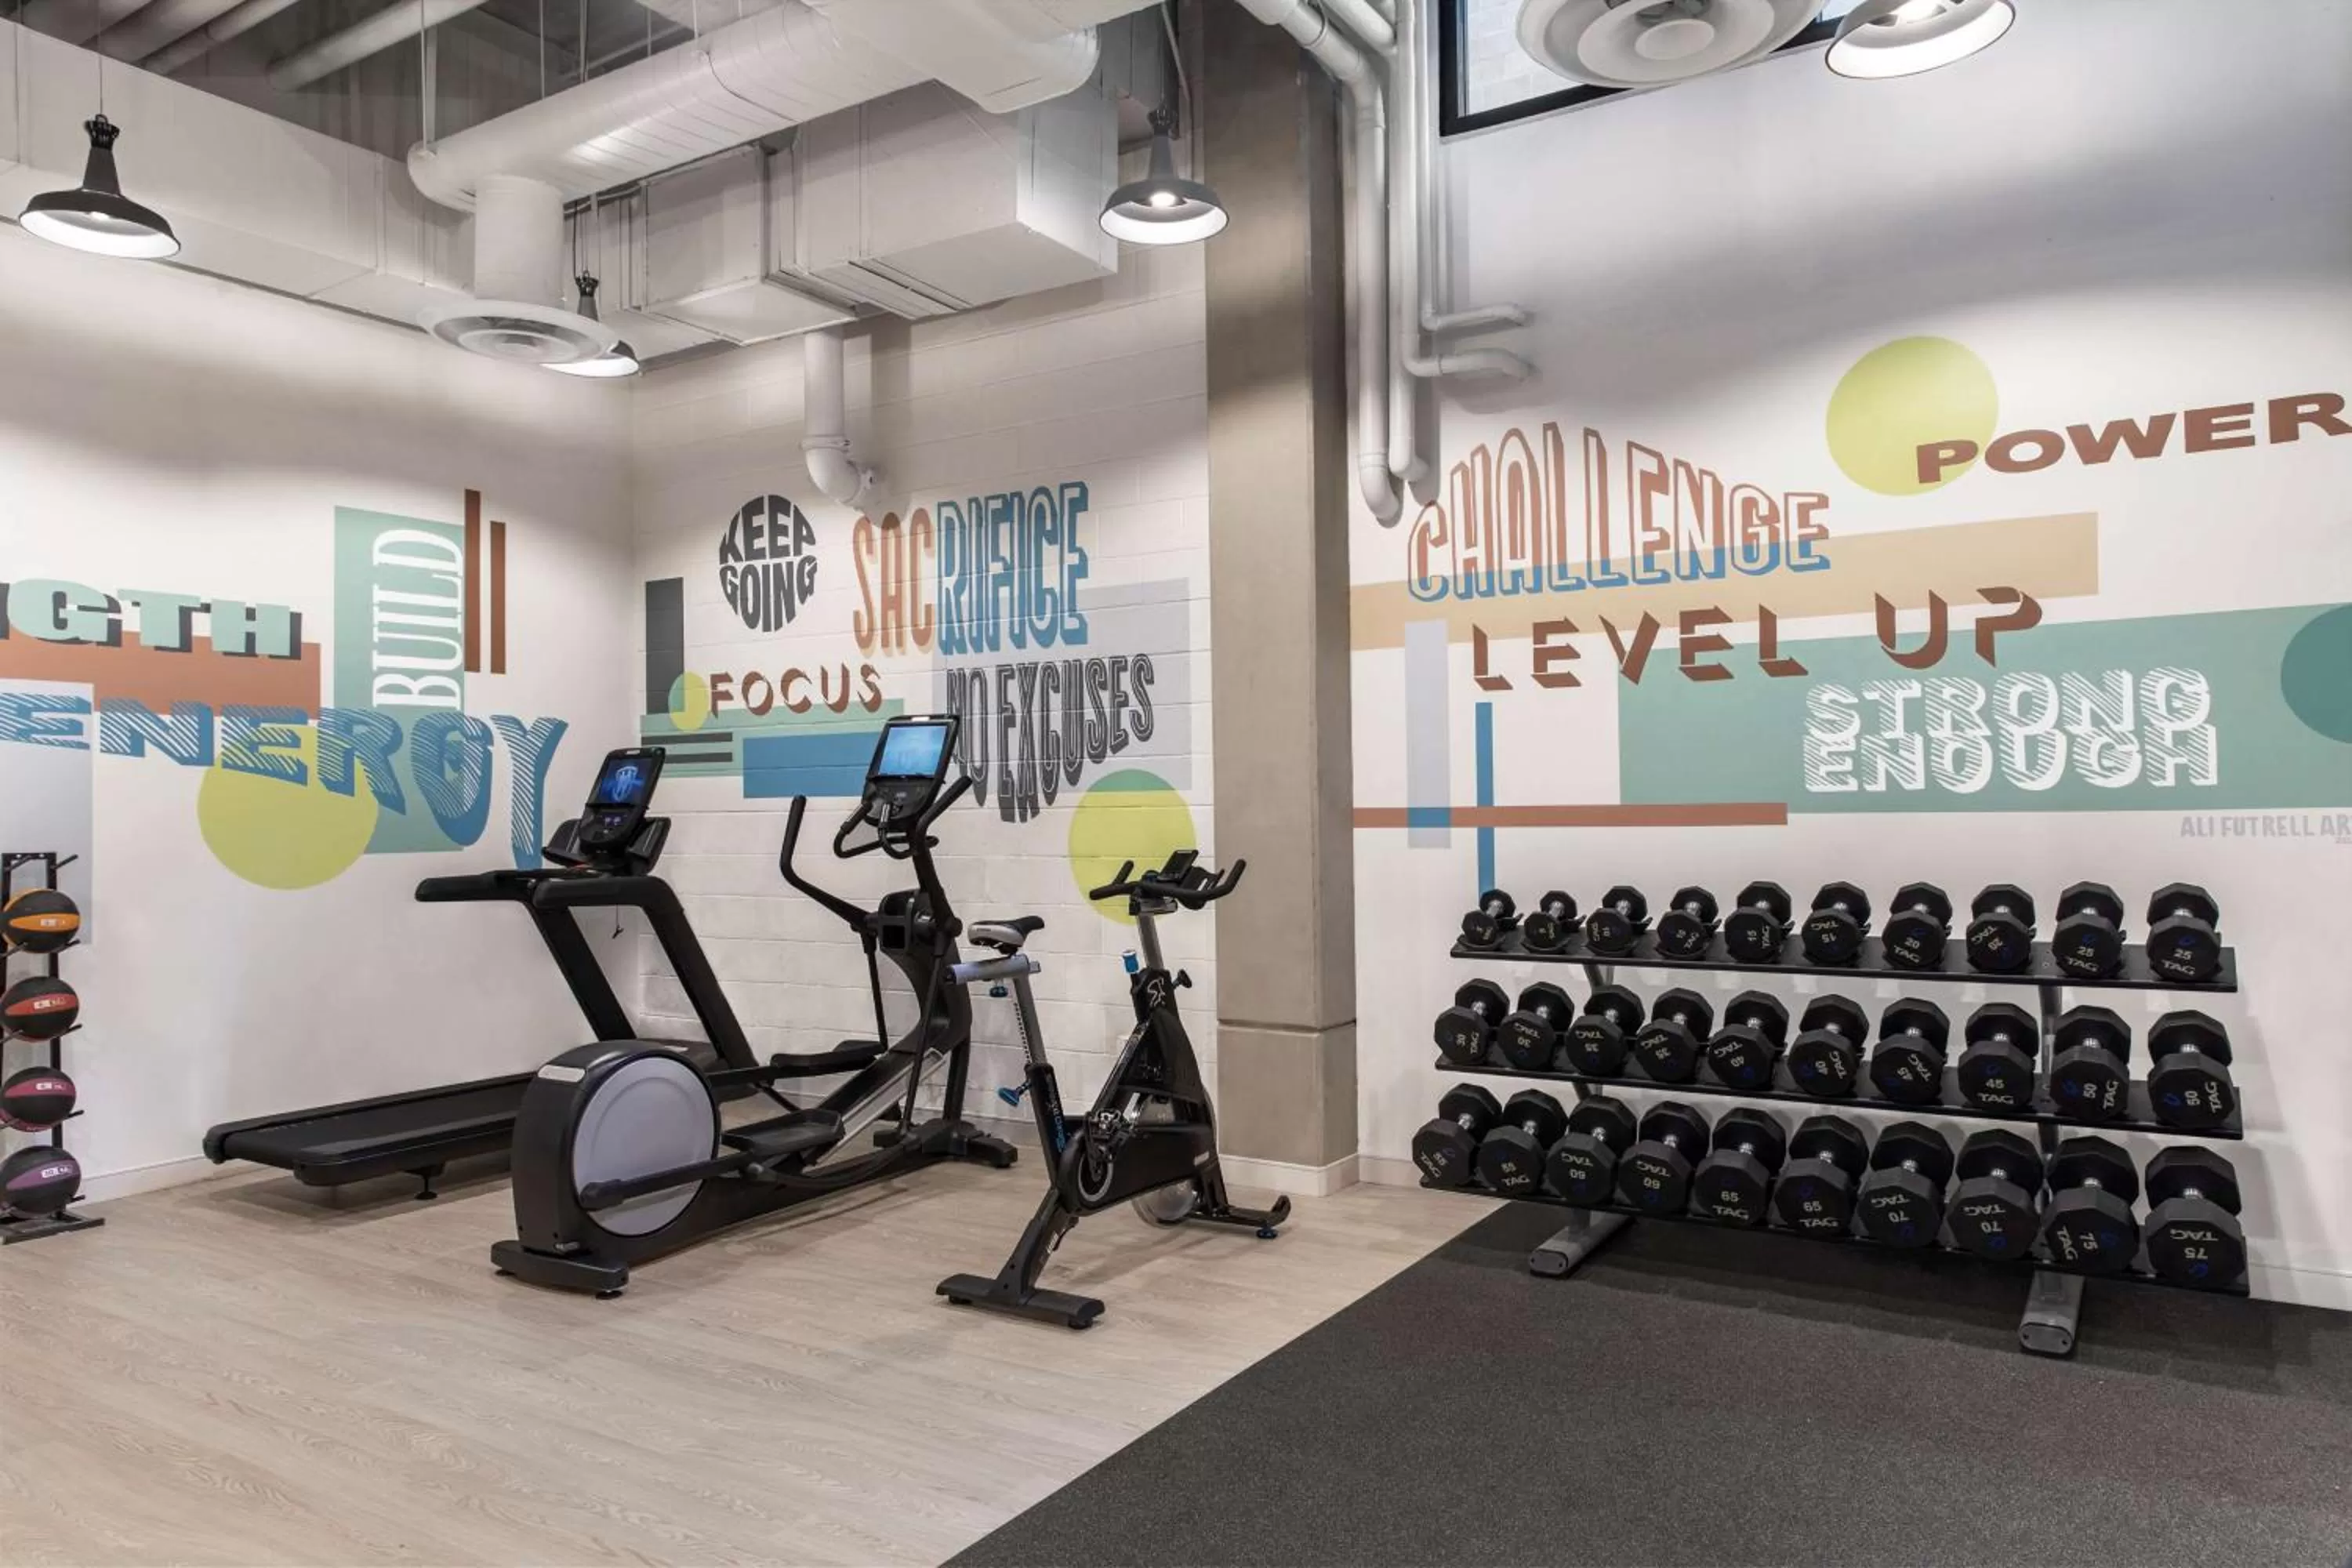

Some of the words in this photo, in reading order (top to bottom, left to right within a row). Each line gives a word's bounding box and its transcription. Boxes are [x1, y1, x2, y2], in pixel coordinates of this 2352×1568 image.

[1916, 393, 2352, 484] POWER
[1408, 422, 1831, 602] CHALLENGE
[719, 494, 816, 564] KEEP
[853, 481, 1089, 657] SACRIFICE
[719, 555, 818, 632] GOING
[0, 579, 303, 659] GTH
[372, 528, 464, 712] BUILD
[1472, 603, 1809, 692] LEVEL
[1875, 586, 2043, 670] UP
[710, 662, 882, 727] FOCUS
[1806, 666, 2211, 742] STRONG
[946, 667, 989, 807] NO
[996, 653, 1155, 824] EXCUSES
[1802, 723, 2219, 794] ENOUGH
[0, 692, 569, 870] ENERGY
[2180, 815, 2215, 837] ALI
[2220, 814, 2315, 837] FUTRELL
[2320, 813, 2352, 837] AR
[1810, 920, 1839, 931] TAG
[1904, 936, 1920, 949] 20
[1970, 924, 1998, 946] TAG
[1893, 945, 1922, 964] TAG
[2077, 946, 2095, 957] 25
[2172, 948, 2194, 961] 25
[2064, 955, 2100, 973] TAG
[2161, 958, 2196, 976] TAG
[1514, 1021, 1541, 1039] TAG
[1574, 1029, 1605, 1040] TAG
[1470, 1030, 1480, 1054] TAG
[1640, 1033, 1669, 1050] TAG
[1713, 1041, 1744, 1058] TAG
[1730, 1055, 1745, 1067] 40
[1815, 1060, 1829, 1076] 40
[1828, 1050, 1848, 1080] TAG
[1907, 1053, 1933, 1082] TAG
[1896, 1066, 1914, 1081] 45
[1984, 1078, 2005, 1090] 45
[2082, 1082, 2099, 1099] 50
[1976, 1092, 2015, 1105] TAG
[2102, 1078, 2120, 1111] TAG
[2183, 1090, 2201, 1106] 50
[2204, 1080, 2223, 1114] TAG
[1419, 1150, 1443, 1178] TAG
[1560, 1151, 1595, 1167] TAG
[1635, 1159, 1671, 1178] TAG
[1501, 1174, 1531, 1187] TAG
[1643, 1177, 1661, 1190] 60
[1720, 1190, 1741, 1203] 65
[1869, 1193, 1911, 1208] TAG
[1711, 1204, 1751, 1221] TAG
[1802, 1200, 1824, 1213] 65
[1962, 1203, 2007, 1216] TAG
[1798, 1216, 1840, 1229] TAG
[1887, 1210, 1911, 1224] 70
[1980, 1221, 2003, 1234] 70
[2169, 1228, 2220, 1242] TAG
[2055, 1224, 2079, 1261] TAG
[2078, 1231, 2100, 1250] 75
[2183, 1247, 2209, 1260] 75
